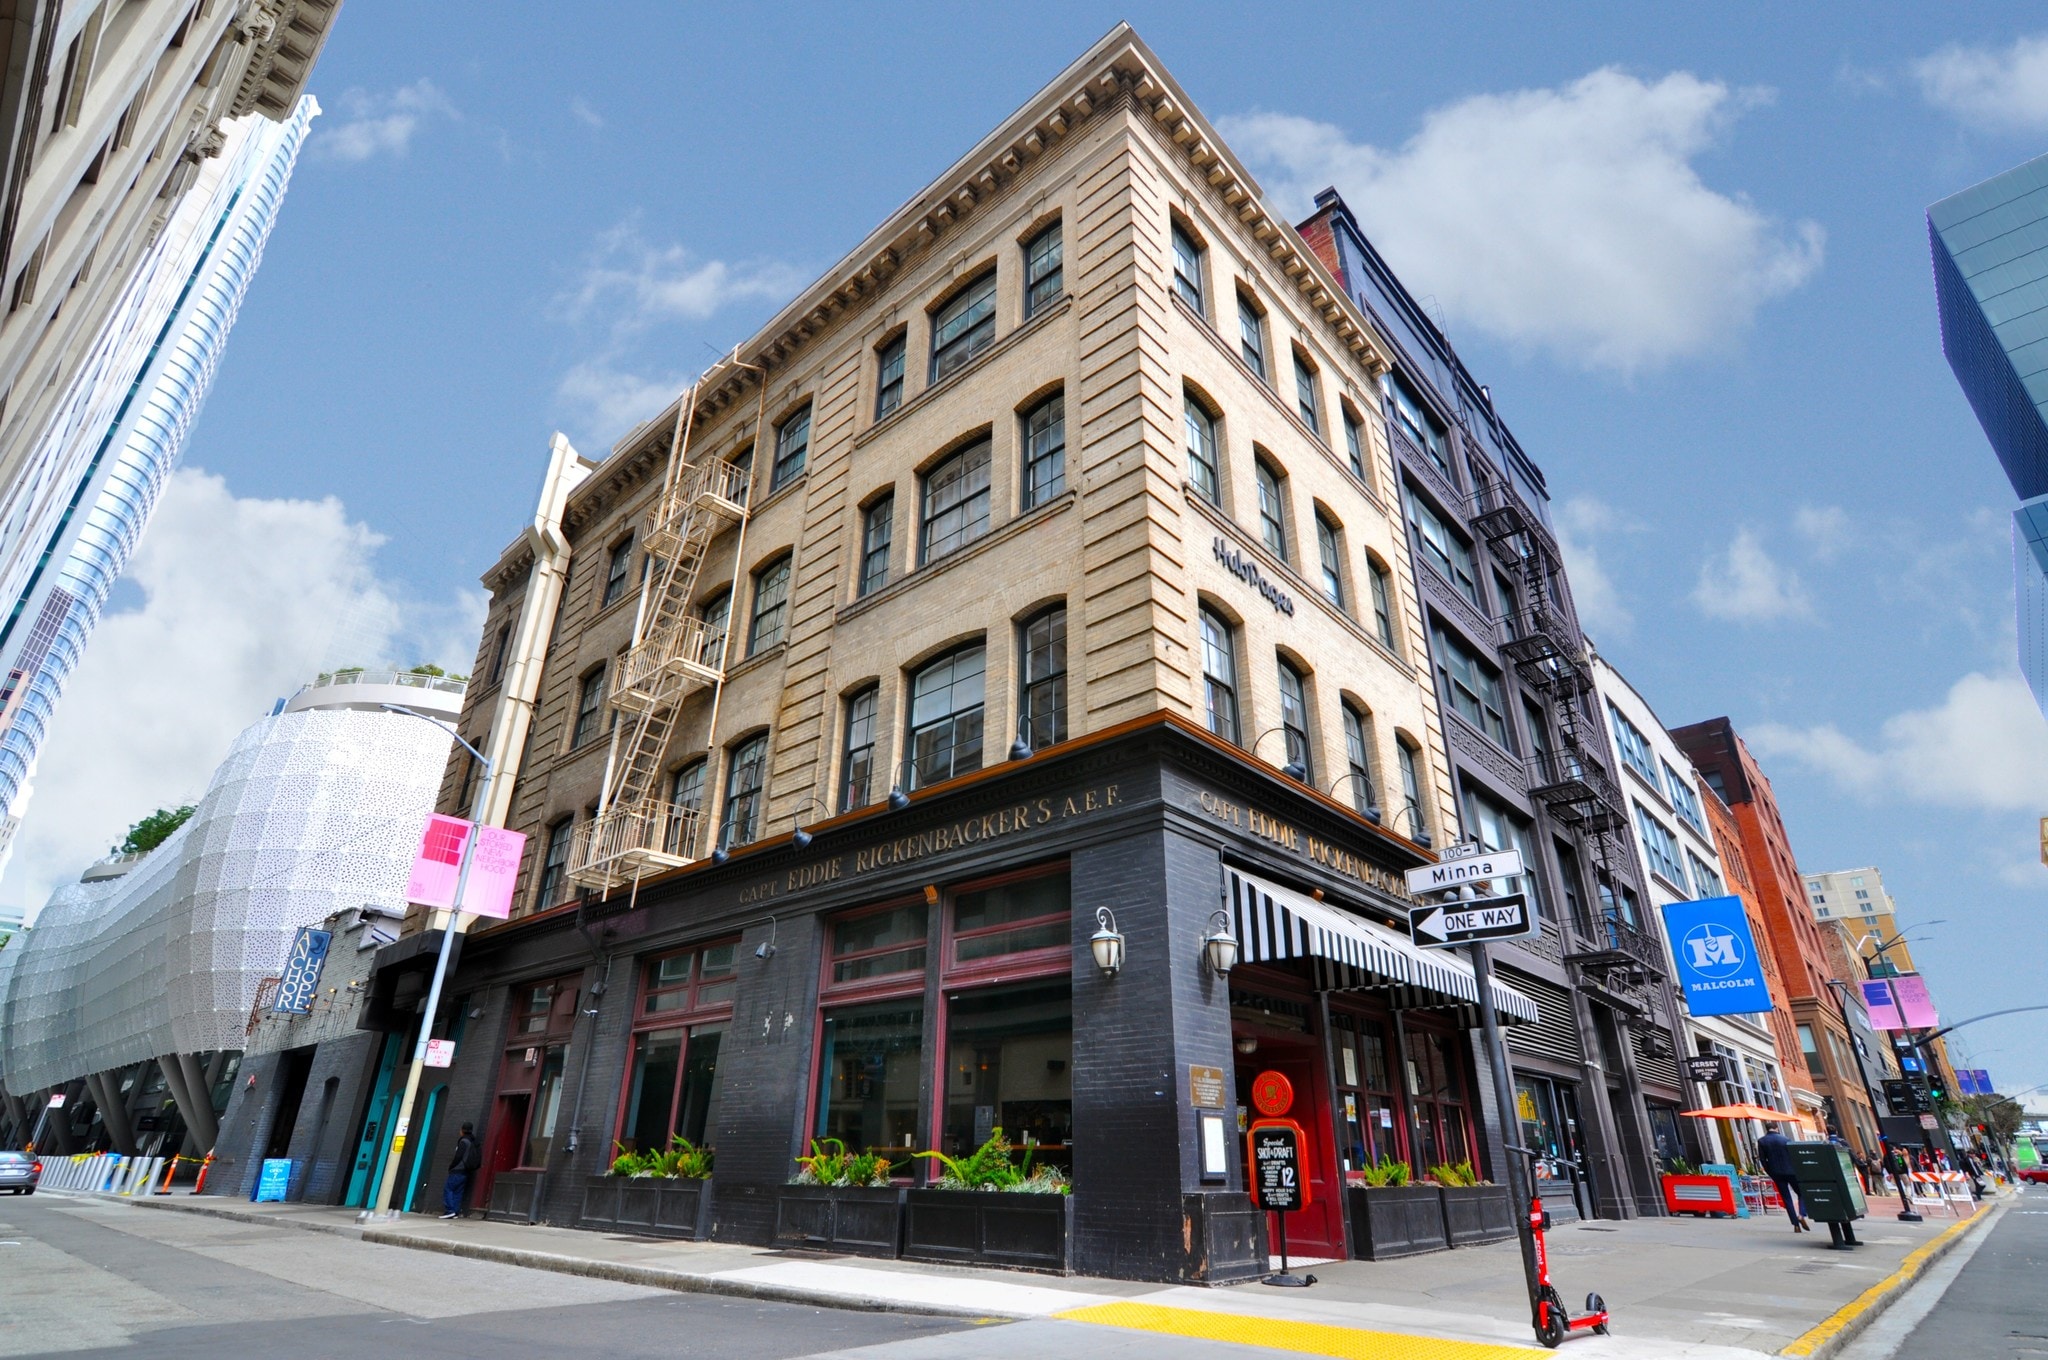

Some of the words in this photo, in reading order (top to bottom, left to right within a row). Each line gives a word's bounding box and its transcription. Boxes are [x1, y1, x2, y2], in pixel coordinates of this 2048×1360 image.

[1201, 791, 1243, 828] CAPT.
[1248, 807, 1299, 853] EDDIE
[483, 847, 504, 858] NEW
[787, 857, 842, 892] EDDIE
[856, 797, 1051, 874] RICKENBACKER'S
[1444, 847, 1463, 859] 100
[480, 863, 506, 875] HOOD
[1432, 862, 1493, 883] Minna
[1445, 913, 1477, 931] ONE
[1482, 907, 1515, 926] WAY
[277, 931, 310, 1009] ANCHOR
[293, 957, 321, 1010] HOPE
[1691, 978, 1755, 992] MALCOLM
[1690, 1060, 1719, 1068] JERSEY
[1282, 1167, 1295, 1187] 12
